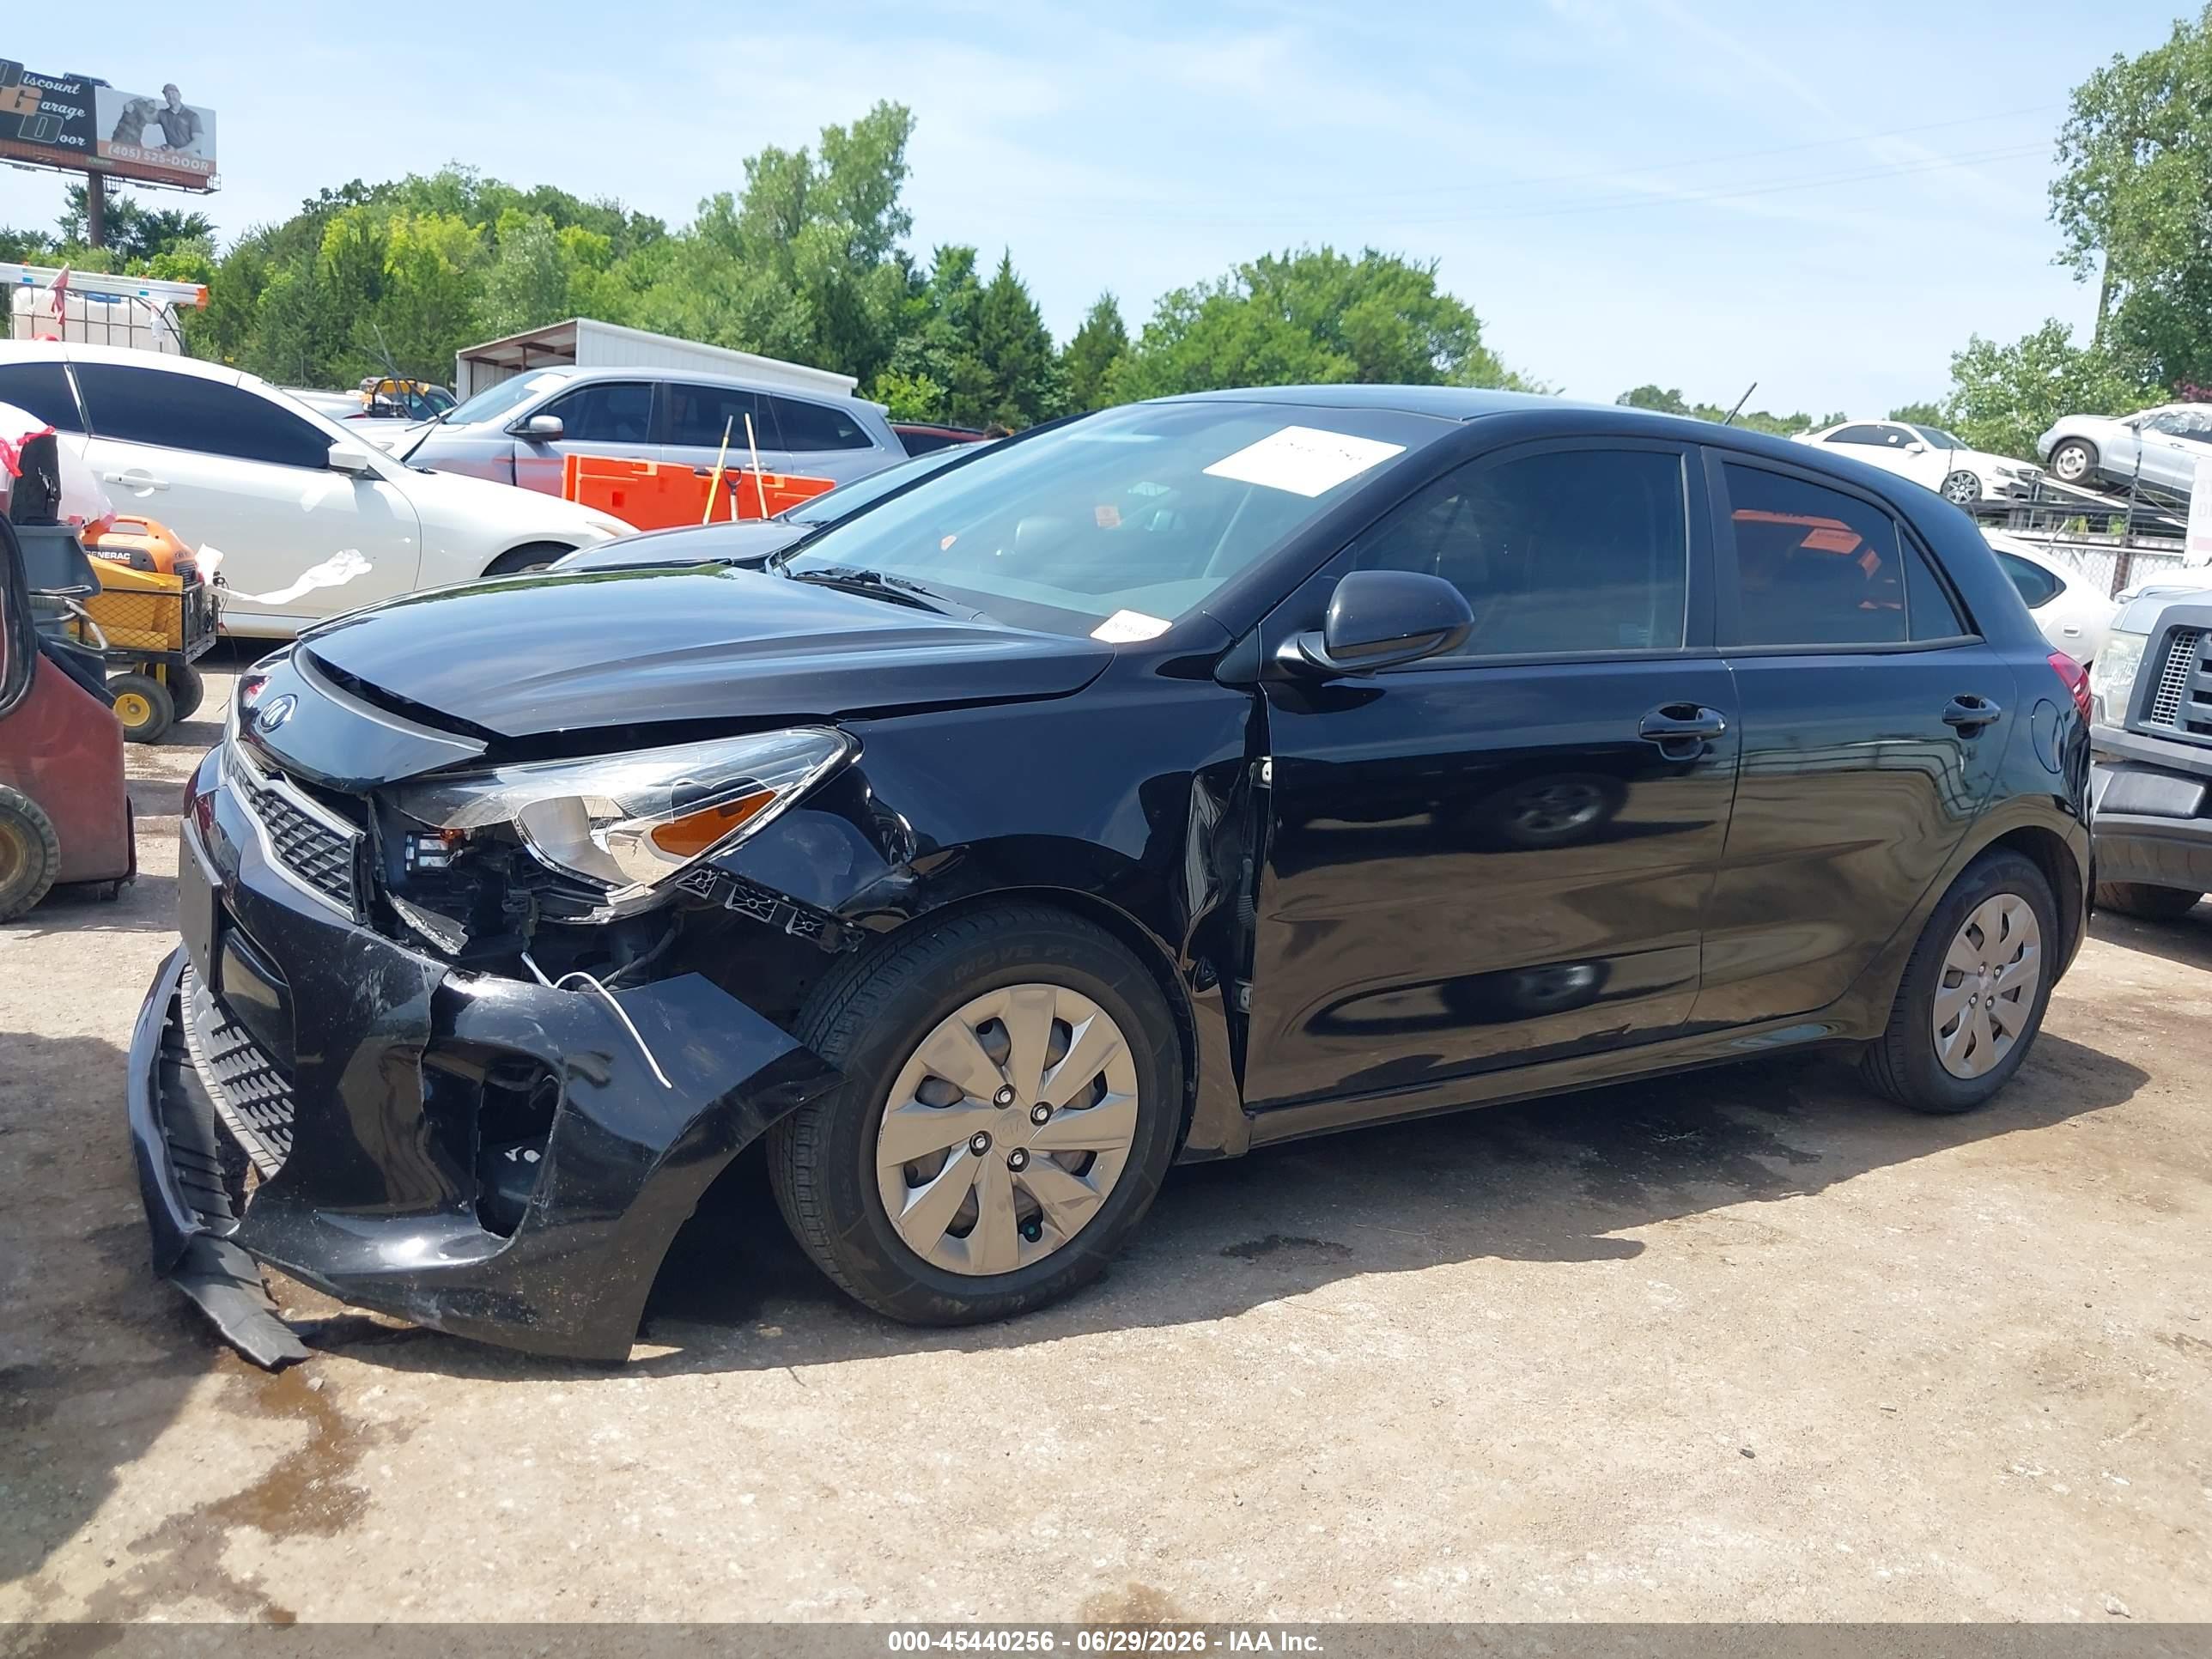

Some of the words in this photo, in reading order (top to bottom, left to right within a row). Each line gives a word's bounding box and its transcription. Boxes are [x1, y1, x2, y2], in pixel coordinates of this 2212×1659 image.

[0, 84, 85, 120] Garage
[17, 112, 86, 144] Door
[108, 143, 141, 160] (405)
[143, 150, 210, 171] 525-DOOR
